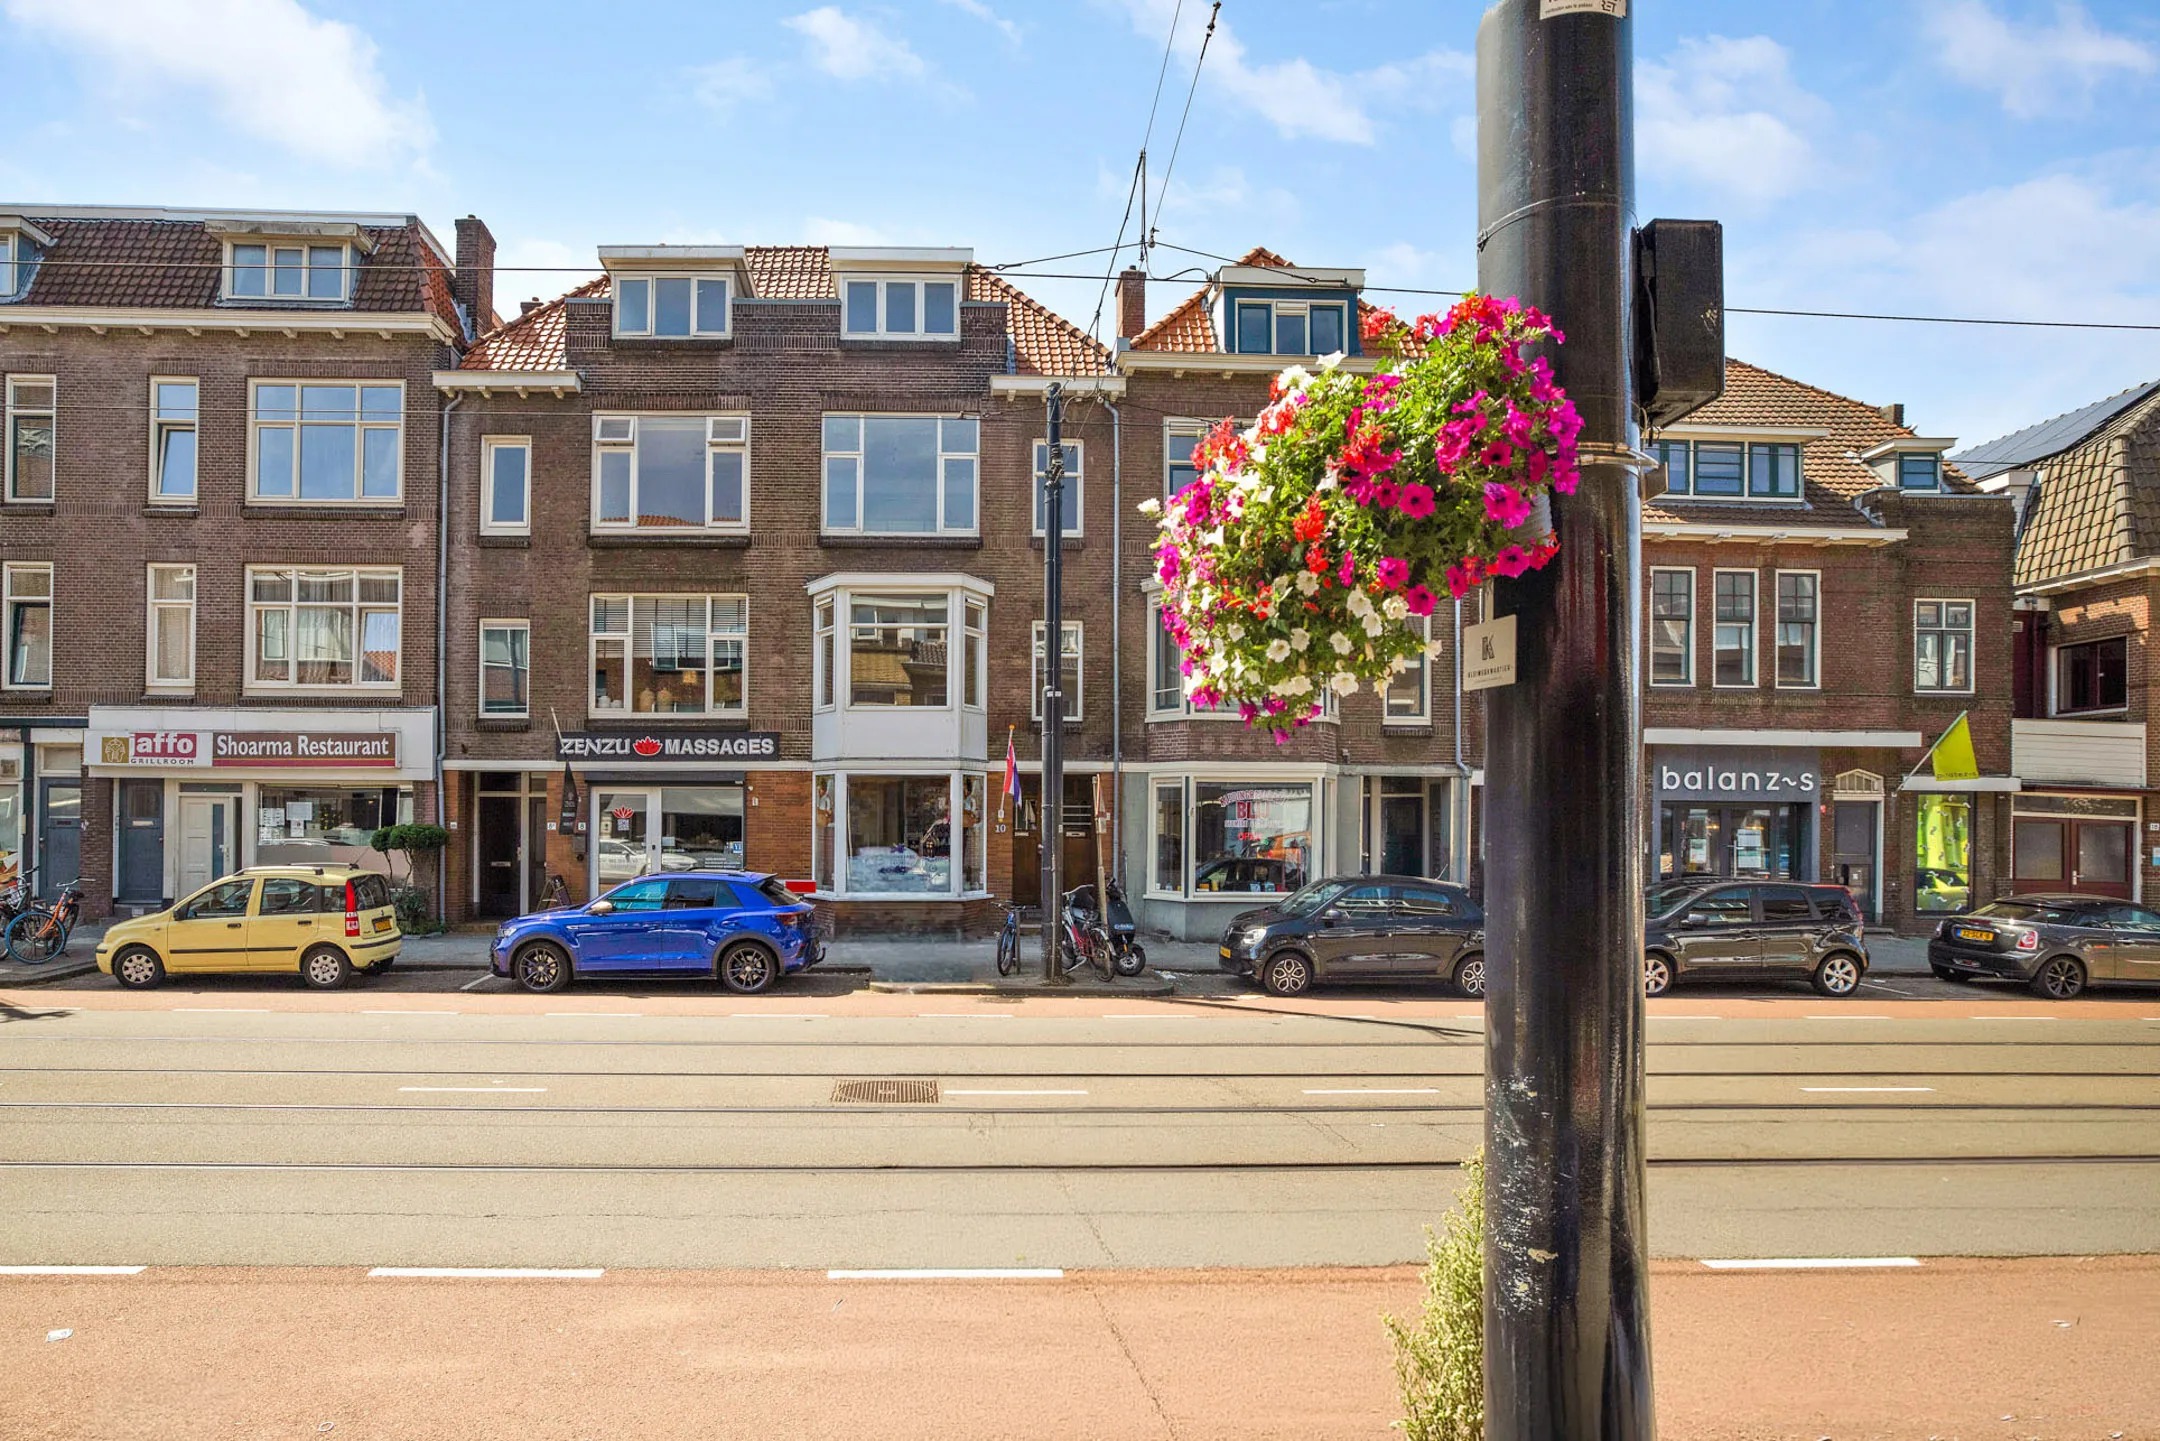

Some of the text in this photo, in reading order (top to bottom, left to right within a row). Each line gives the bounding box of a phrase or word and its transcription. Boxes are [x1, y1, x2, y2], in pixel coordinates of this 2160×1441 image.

[216, 735, 389, 757] Shoarma Restaurant
[560, 738, 774, 755] ZENZU MASSAGES
[995, 824, 1006, 833] 10
